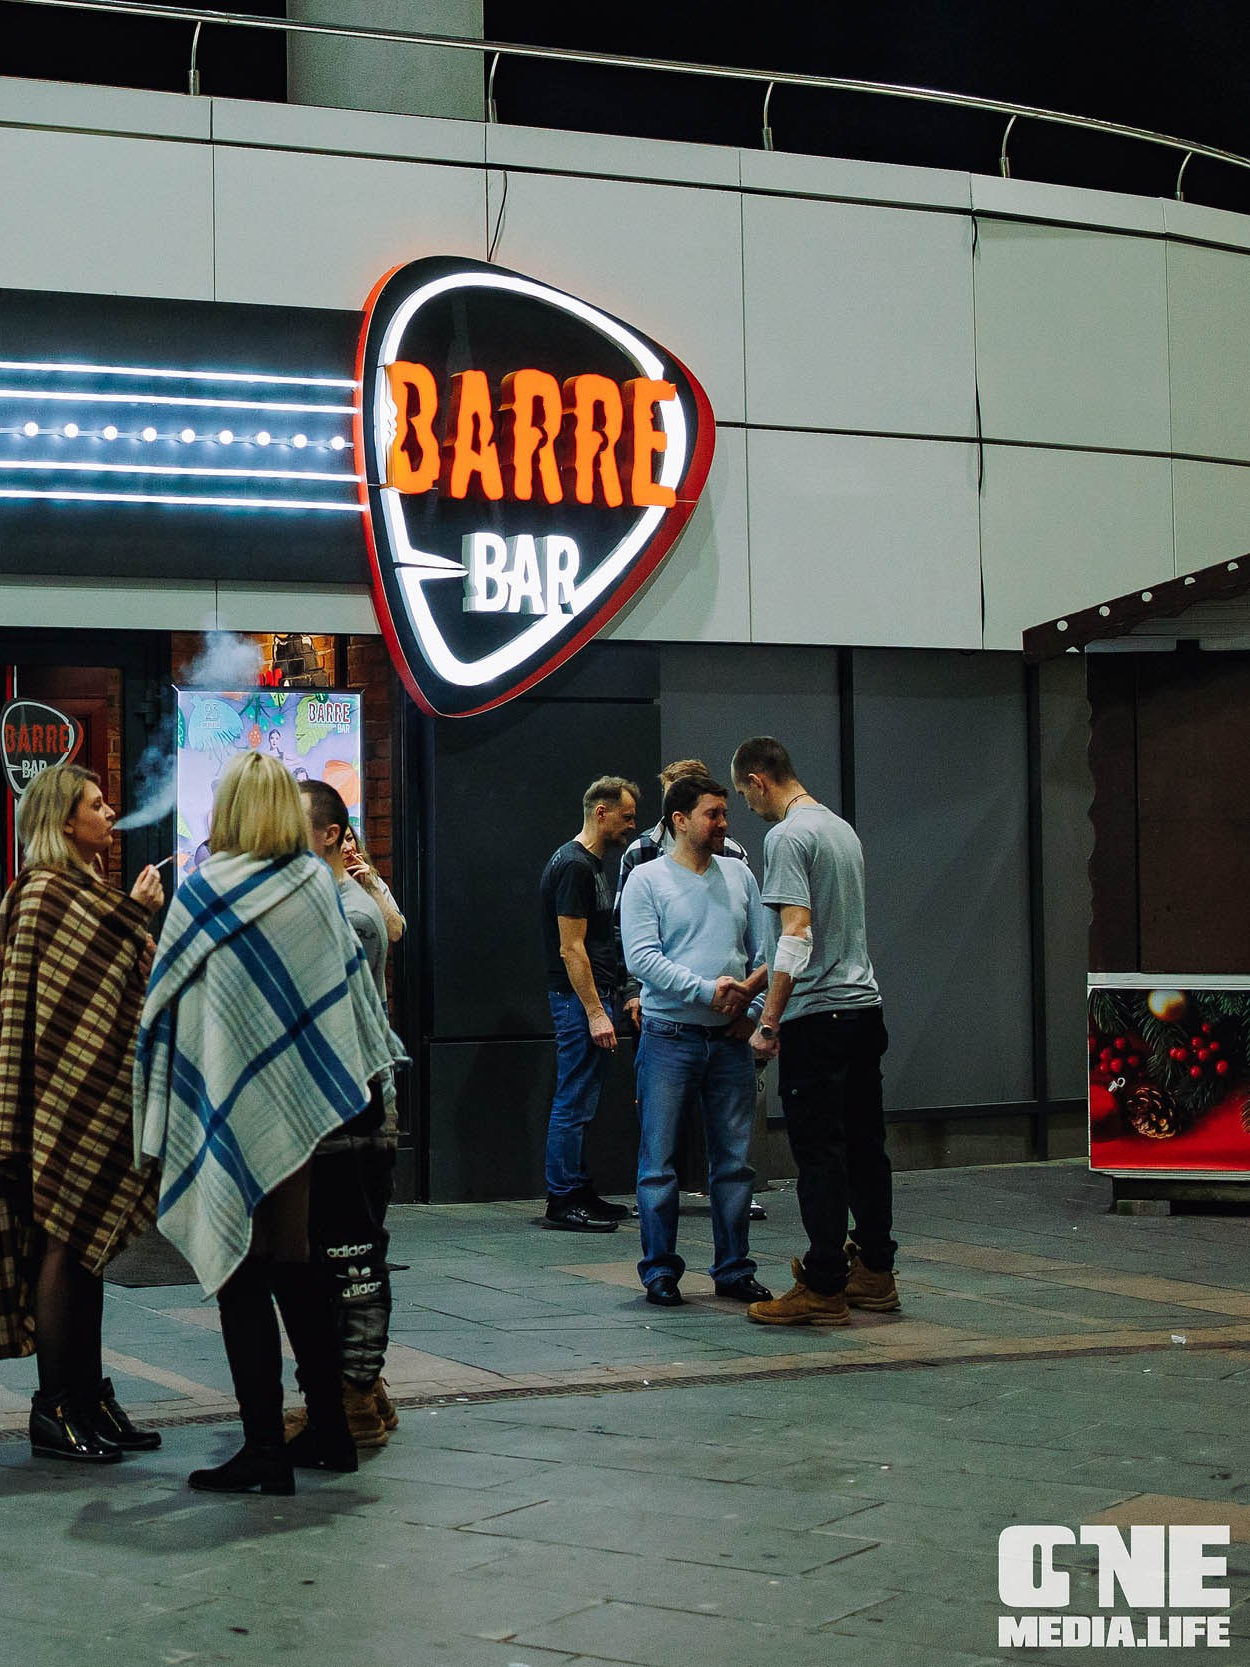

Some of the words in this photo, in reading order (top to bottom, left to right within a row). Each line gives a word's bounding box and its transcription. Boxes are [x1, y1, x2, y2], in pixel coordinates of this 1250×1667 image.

[384, 361, 677, 508] BARRE
[463, 532, 581, 616] BAR
[307, 702, 351, 724] BARRE
[5, 723, 70, 753] BARRE
[337, 723, 351, 734] BAR
